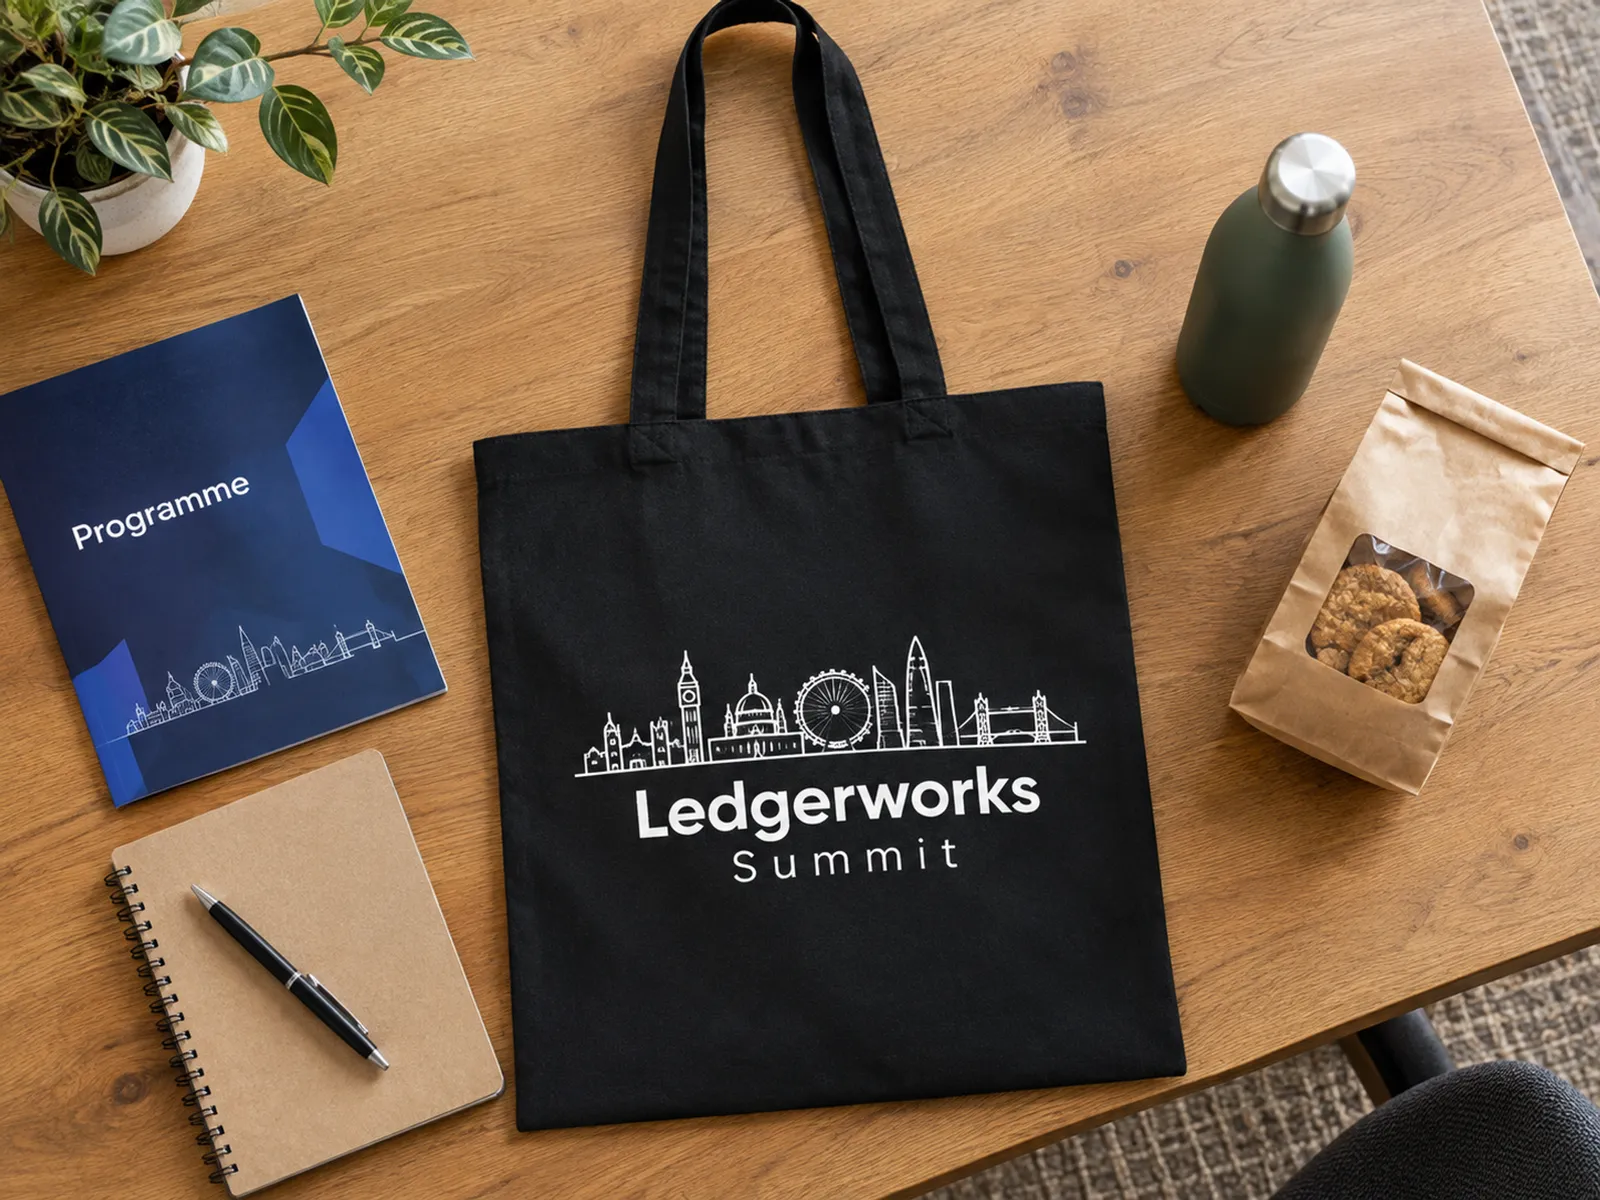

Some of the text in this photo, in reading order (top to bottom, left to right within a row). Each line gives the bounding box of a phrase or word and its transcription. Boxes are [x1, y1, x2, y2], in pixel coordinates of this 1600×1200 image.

[71, 476, 250, 551] Programme
[635, 765, 1041, 842] Ledgerworks
[733, 838, 958, 883] Summit
